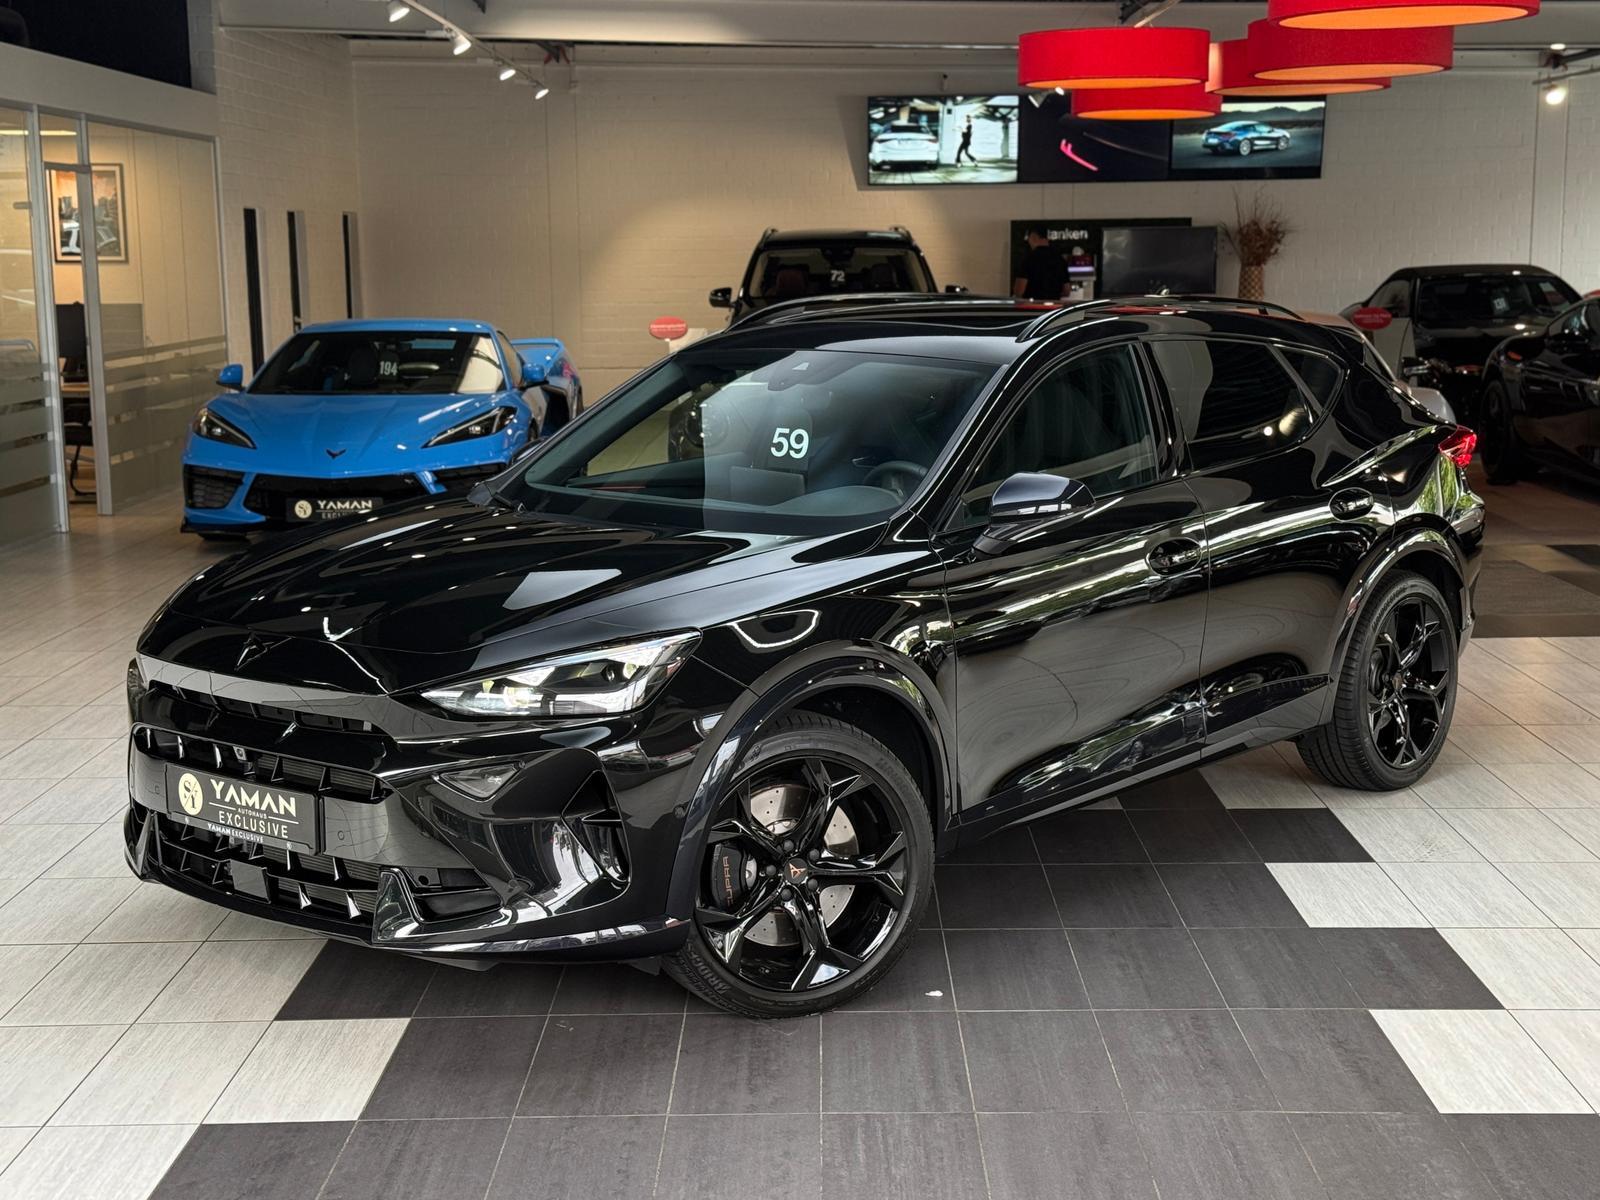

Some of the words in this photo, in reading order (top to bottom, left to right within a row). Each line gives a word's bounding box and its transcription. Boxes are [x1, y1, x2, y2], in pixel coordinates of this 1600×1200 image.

[830, 270, 845, 281] 72
[380, 361, 398, 376] 194
[770, 427, 809, 459] 59
[317, 500, 373, 510] YAMAN
[210, 778, 297, 817] YAMAN
[237, 807, 268, 819] AUTOHAUS
[207, 822, 231, 836] YAMAN
[231, 829, 264, 843] EXCLUSIVE
[218, 810, 289, 839] EXCLUSIVE
